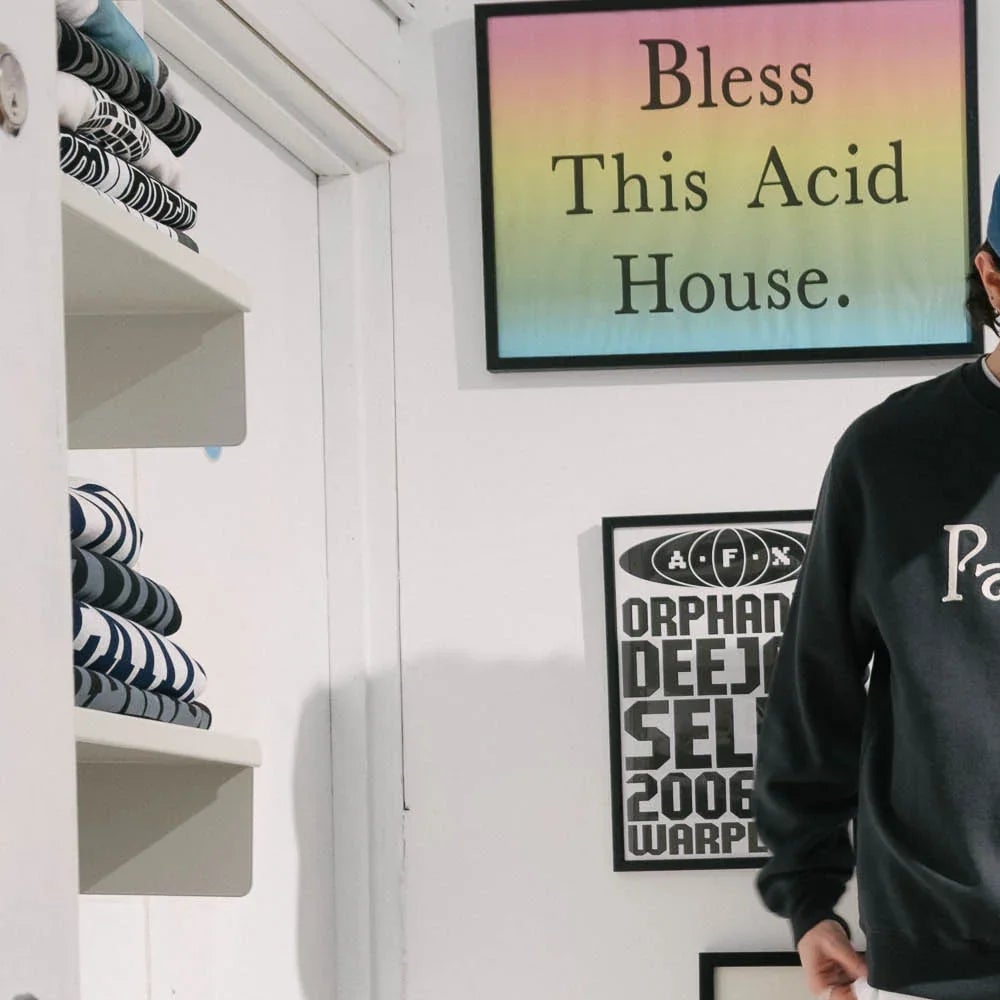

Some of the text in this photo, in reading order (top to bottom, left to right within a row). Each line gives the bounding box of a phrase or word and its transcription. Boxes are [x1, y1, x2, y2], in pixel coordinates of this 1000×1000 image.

[639, 38, 815, 111] Bless
[551, 139, 909, 215] This Acid
[612, 252, 850, 315] House.
[624, 697, 768, 771] SEL
